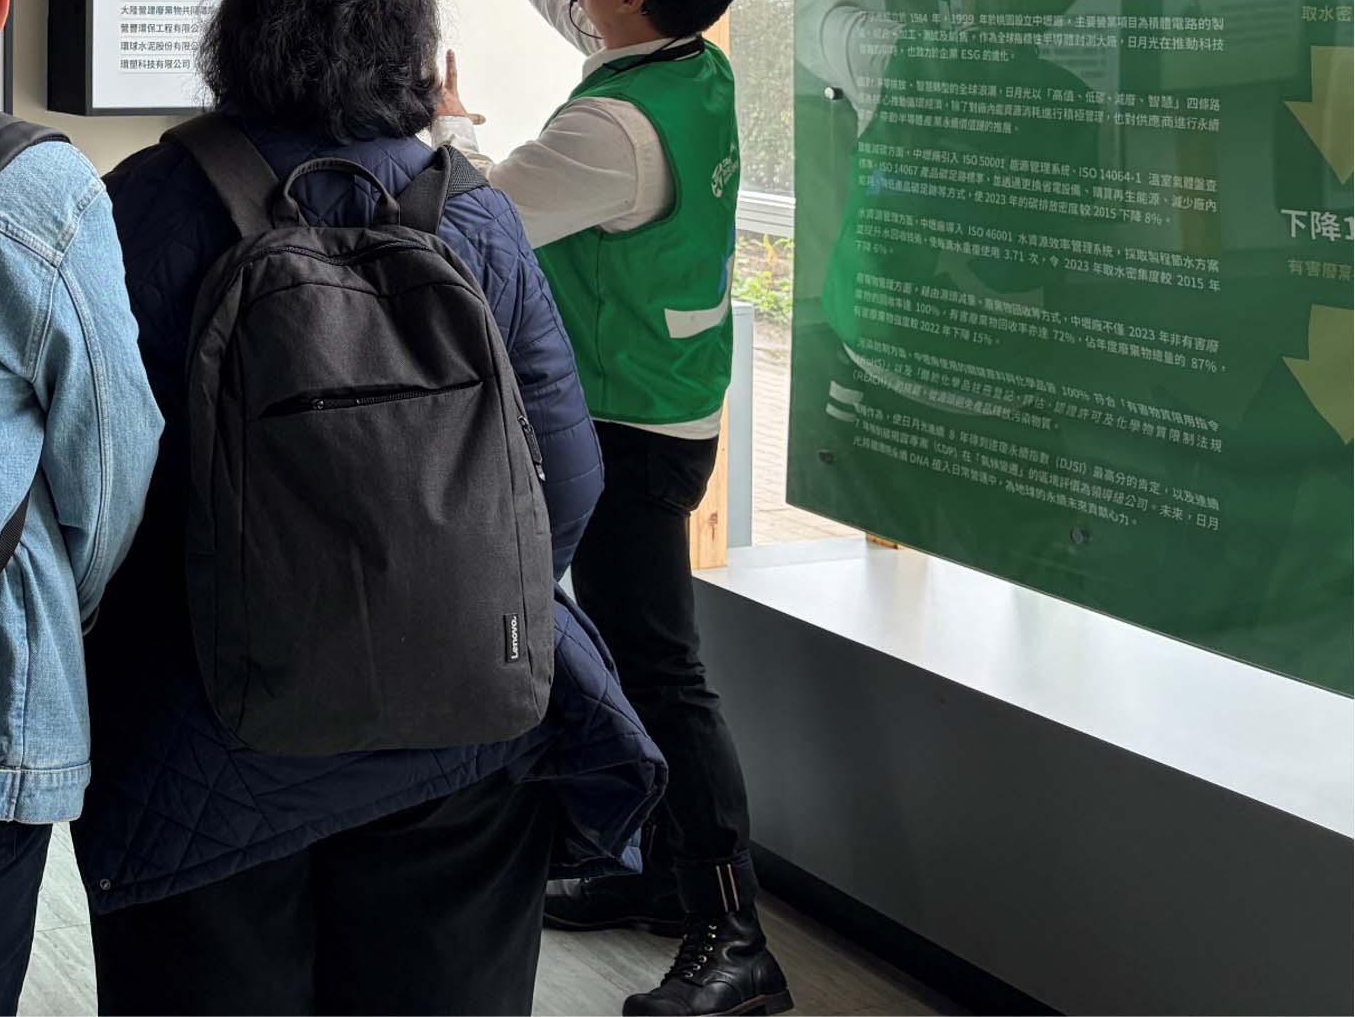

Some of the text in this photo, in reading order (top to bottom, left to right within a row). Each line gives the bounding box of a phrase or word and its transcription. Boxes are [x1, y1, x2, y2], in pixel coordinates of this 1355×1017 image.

[961, 49, 981, 60] ESG
[963, 155, 978, 166] ISO
[980, 157, 1006, 169] 50001
[1100, 169, 1142, 184] 14064-1
[985, 193, 1006, 205] 2023
[1094, 207, 1117, 220] 2015
[968, 226, 984, 238] ISO
[1065, 258, 1090, 272] 2023
[1177, 274, 1204, 290] 2015
[1128, 325, 1156, 341] 2023
[510, 615, 519, 659] Lenovo
